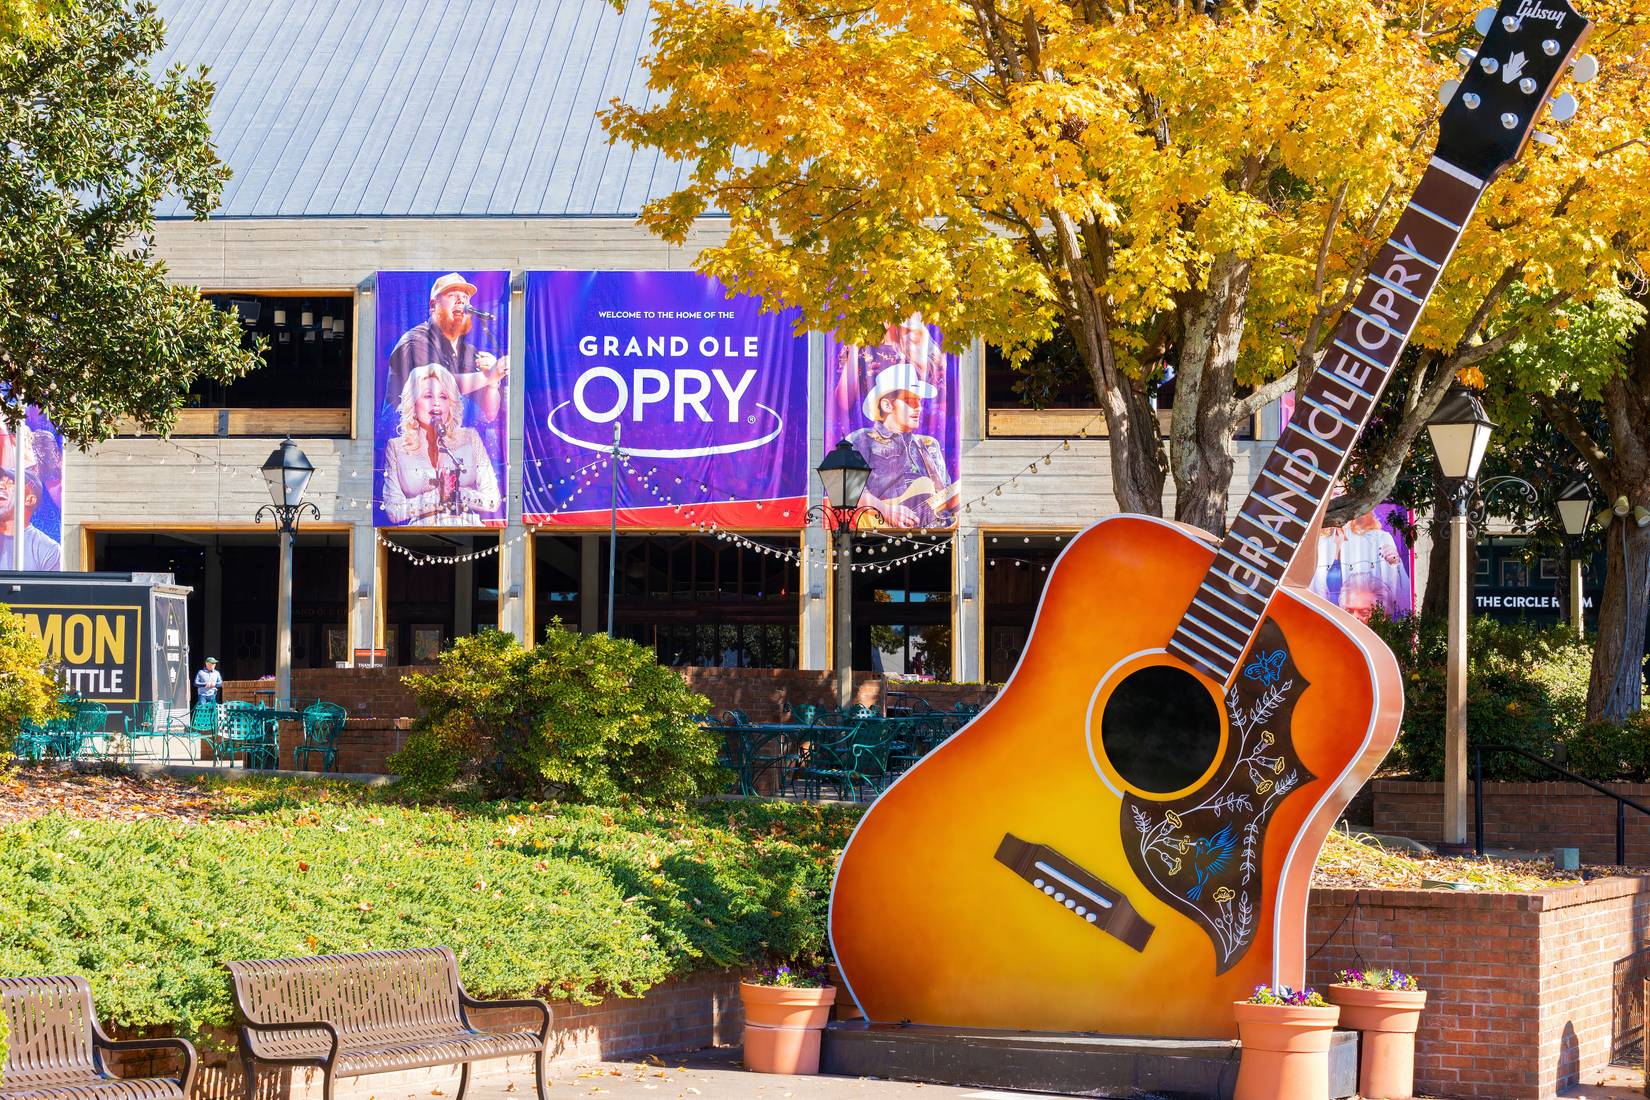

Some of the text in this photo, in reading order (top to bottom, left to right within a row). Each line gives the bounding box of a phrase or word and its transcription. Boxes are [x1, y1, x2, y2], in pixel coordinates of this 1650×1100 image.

[1516, 0, 1567, 29] Gibson
[599, 311, 734, 319] WELCOME TO THE HOME OF THE
[579, 335, 758, 357] GRAND OLE
[573, 366, 757, 423] OPRY
[1228, 234, 1422, 595] GRAND OLE OPRY
[1476, 596, 1593, 607] THE CIRCLE RM
[54, 669, 123, 692] ITTLE
